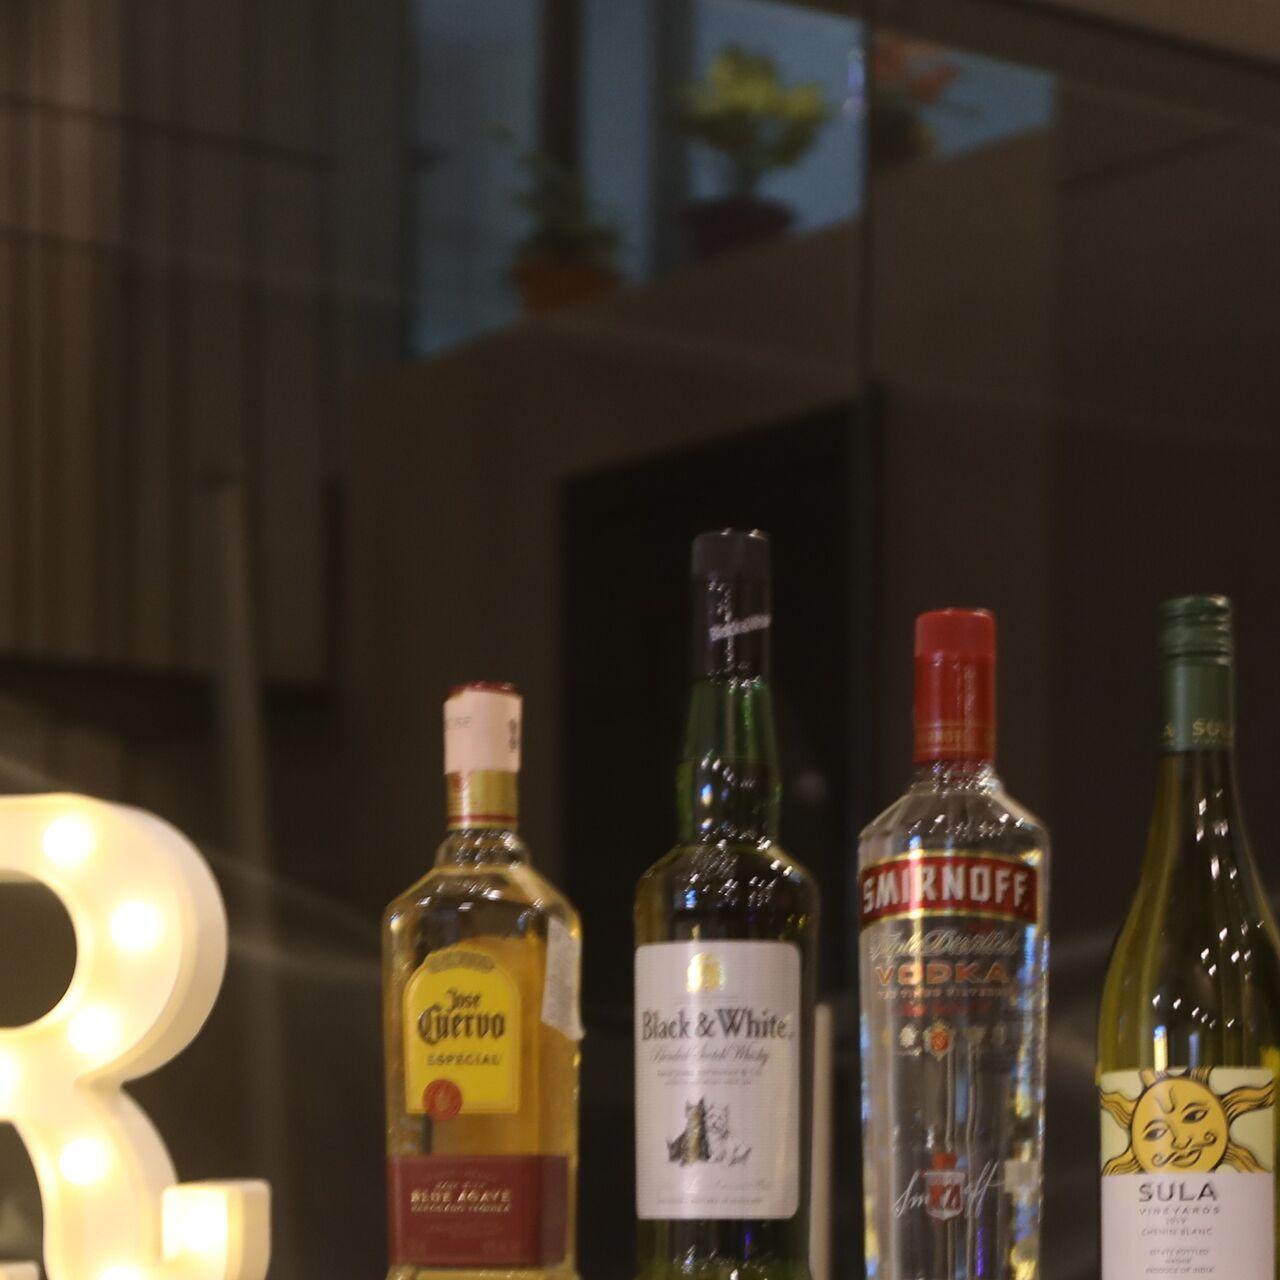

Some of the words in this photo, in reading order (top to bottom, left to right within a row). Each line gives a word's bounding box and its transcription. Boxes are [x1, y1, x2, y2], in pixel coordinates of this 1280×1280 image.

[863, 864, 1028, 914] SMIRNOFF
[875, 962, 1010, 986] VODKA
[446, 986, 481, 1012] Jose
[417, 1003, 506, 1046] Cuervo
[642, 1008, 690, 1040] Black
[695, 1011, 716, 1038] &
[714, 1007, 787, 1039] White
[427, 1053, 501, 1067] ESPECIAL
[1139, 1182, 1217, 1202] SULA
[1140, 1207, 1220, 1215] VINEYARDS
